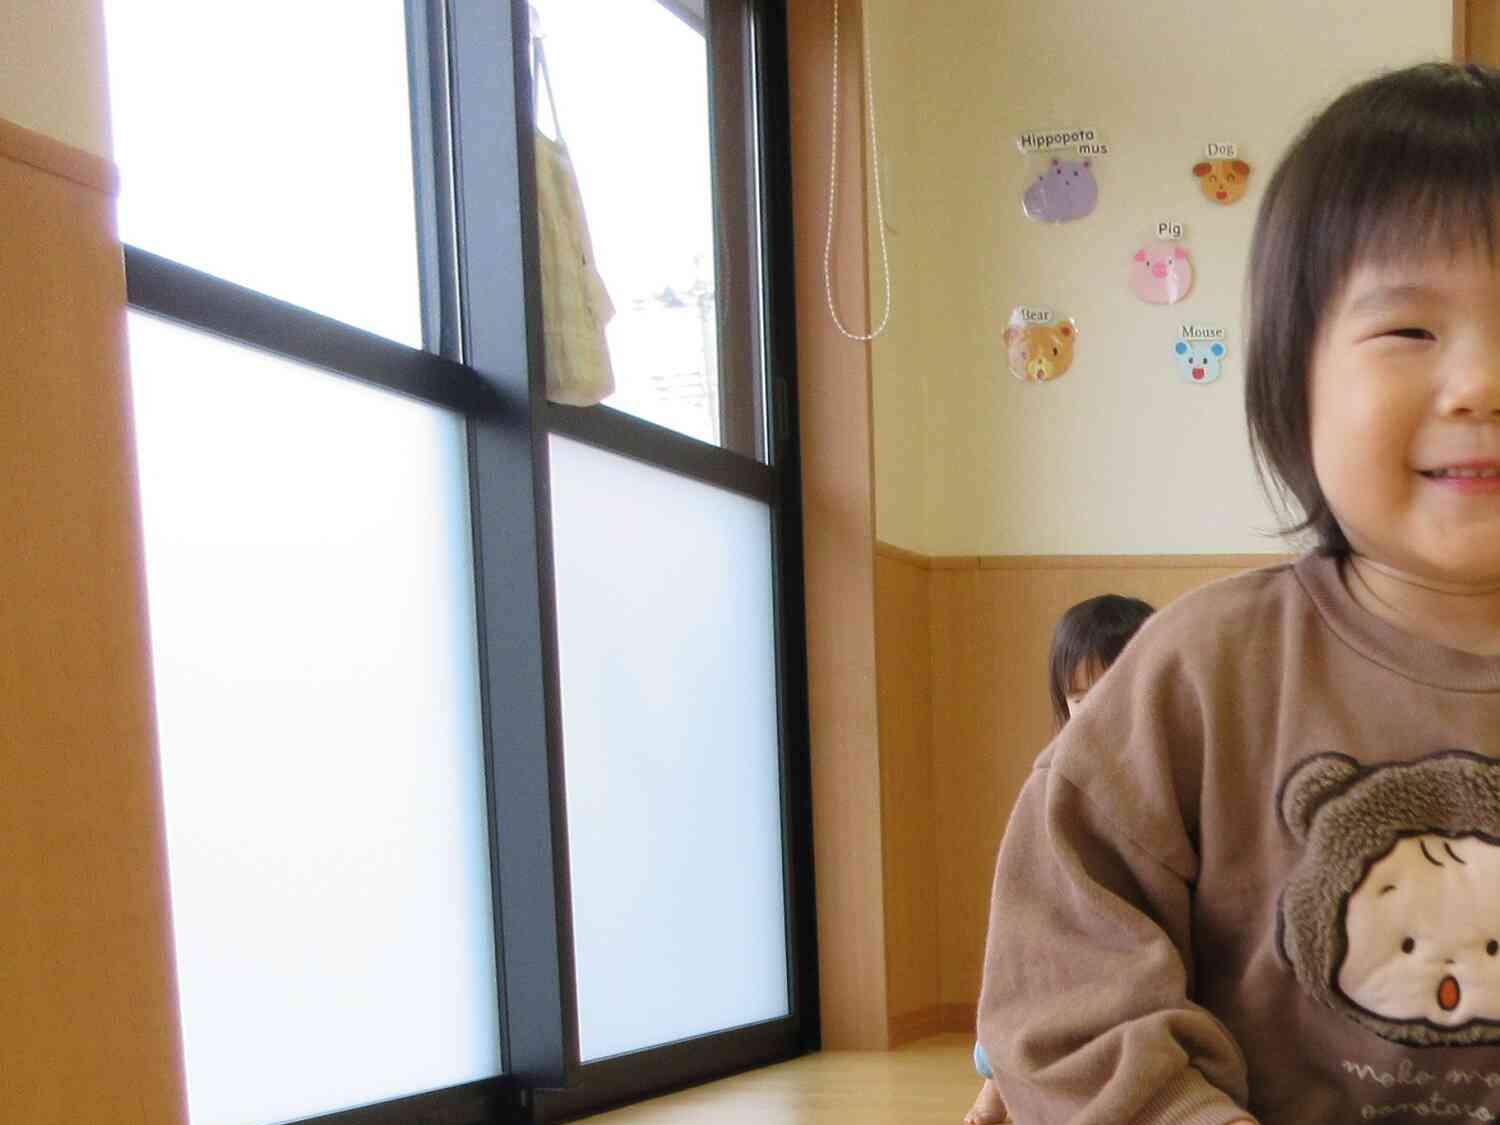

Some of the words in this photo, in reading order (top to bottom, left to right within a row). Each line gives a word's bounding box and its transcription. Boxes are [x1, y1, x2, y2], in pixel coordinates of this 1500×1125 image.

[1020, 130, 1095, 149] Hippopota
[1079, 143, 1108, 154] mus
[1207, 143, 1234, 157] Dog
[1158, 222, 1181, 238] Pig
[1021, 309, 1050, 321] Bear
[1181, 325, 1223, 338] Mouse
